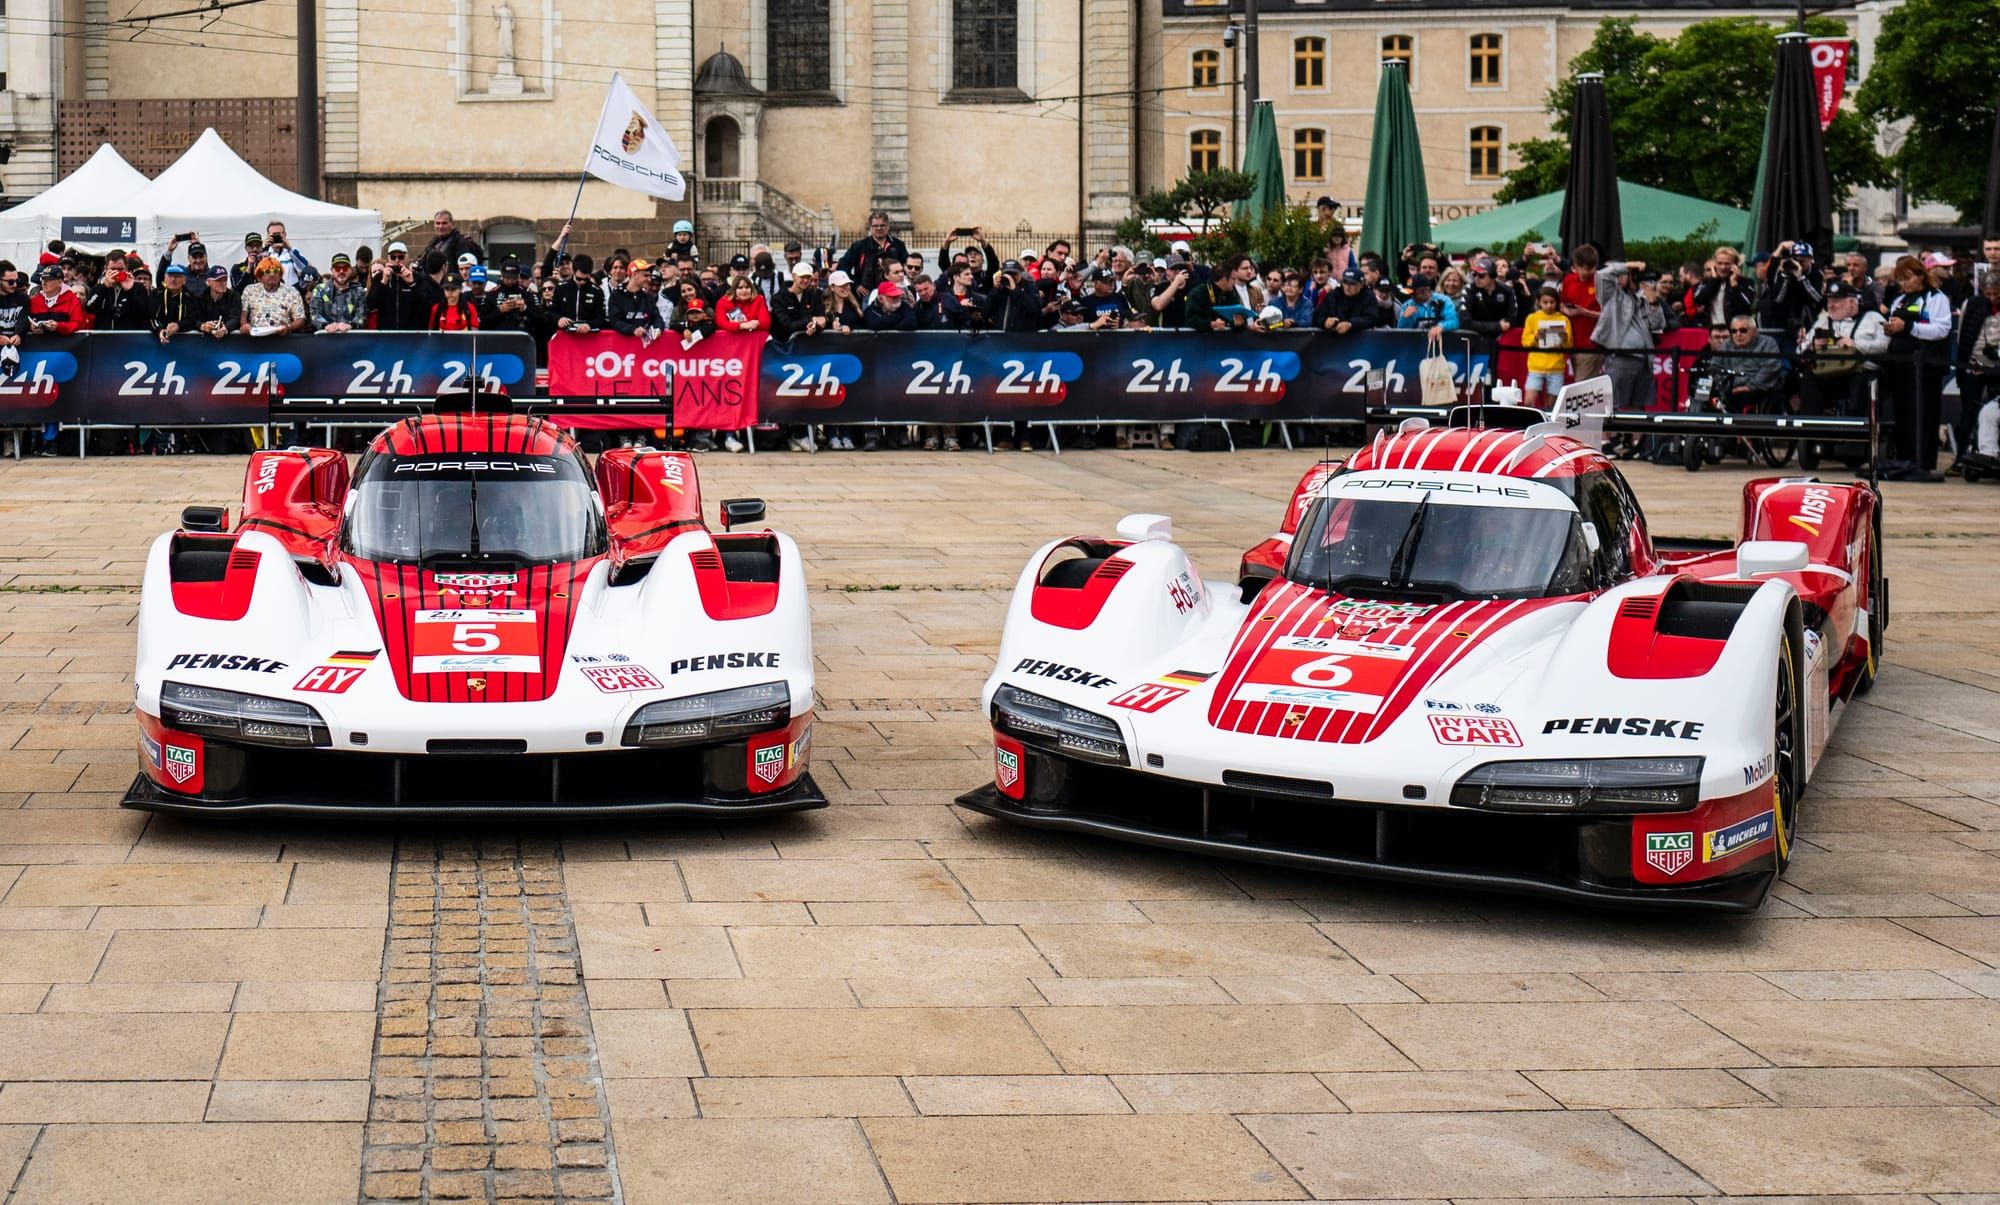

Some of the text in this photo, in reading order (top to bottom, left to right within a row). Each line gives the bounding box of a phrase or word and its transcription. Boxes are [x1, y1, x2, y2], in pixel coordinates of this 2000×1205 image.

[593, 144, 679, 186] PORSCHE
[1432, 206, 1494, 221] HOTE
[346, 360, 413, 394] 24h
[643, 358, 743, 377] course
[906, 360, 971, 394] 24h
[996, 360, 1061, 394] 24h
[1126, 358, 1190, 393] 24h
[1214, 358, 1281, 392] 24h
[118, 361, 186, 396] 24h
[776, 362, 840, 396] 24h
[394, 461, 556, 474] PORSCHE
[660, 455, 686, 495] Ansys
[1342, 479, 1531, 499] PORSCHE
[1788, 487, 1836, 537] Ansys
[436, 588, 517, 597] Ansys
[452, 623, 501, 653] 5
[166, 653, 289, 674] PENSKE
[441, 656, 512, 665] WEC
[670, 652, 781, 675] PENSKE
[1291, 654, 1353, 688] 6
[297, 666, 359, 691] HY
[585, 666, 646, 677] HYPER
[1012, 657, 1118, 689] PENSKE
[596, 675, 657, 691] CAR
[1110, 683, 1180, 711] HY
[1268, 688, 1351, 701] WEC
[1425, 700, 1461, 711] FIA
[1435, 716, 1507, 729] HYPER
[1541, 717, 1705, 741] PENSKE
[1443, 726, 1515, 744] CAR
[168, 747, 193, 763] TAG
[757, 746, 783, 763] TAG
[999, 751, 1015, 767] TAG
[167, 761, 194, 780] HEUER
[757, 760, 783, 779] HEUER
[1651, 835, 1690, 849] TAG
[1727, 821, 1768, 846] MICHELIN
[1650, 850, 1691, 872] HEUER
